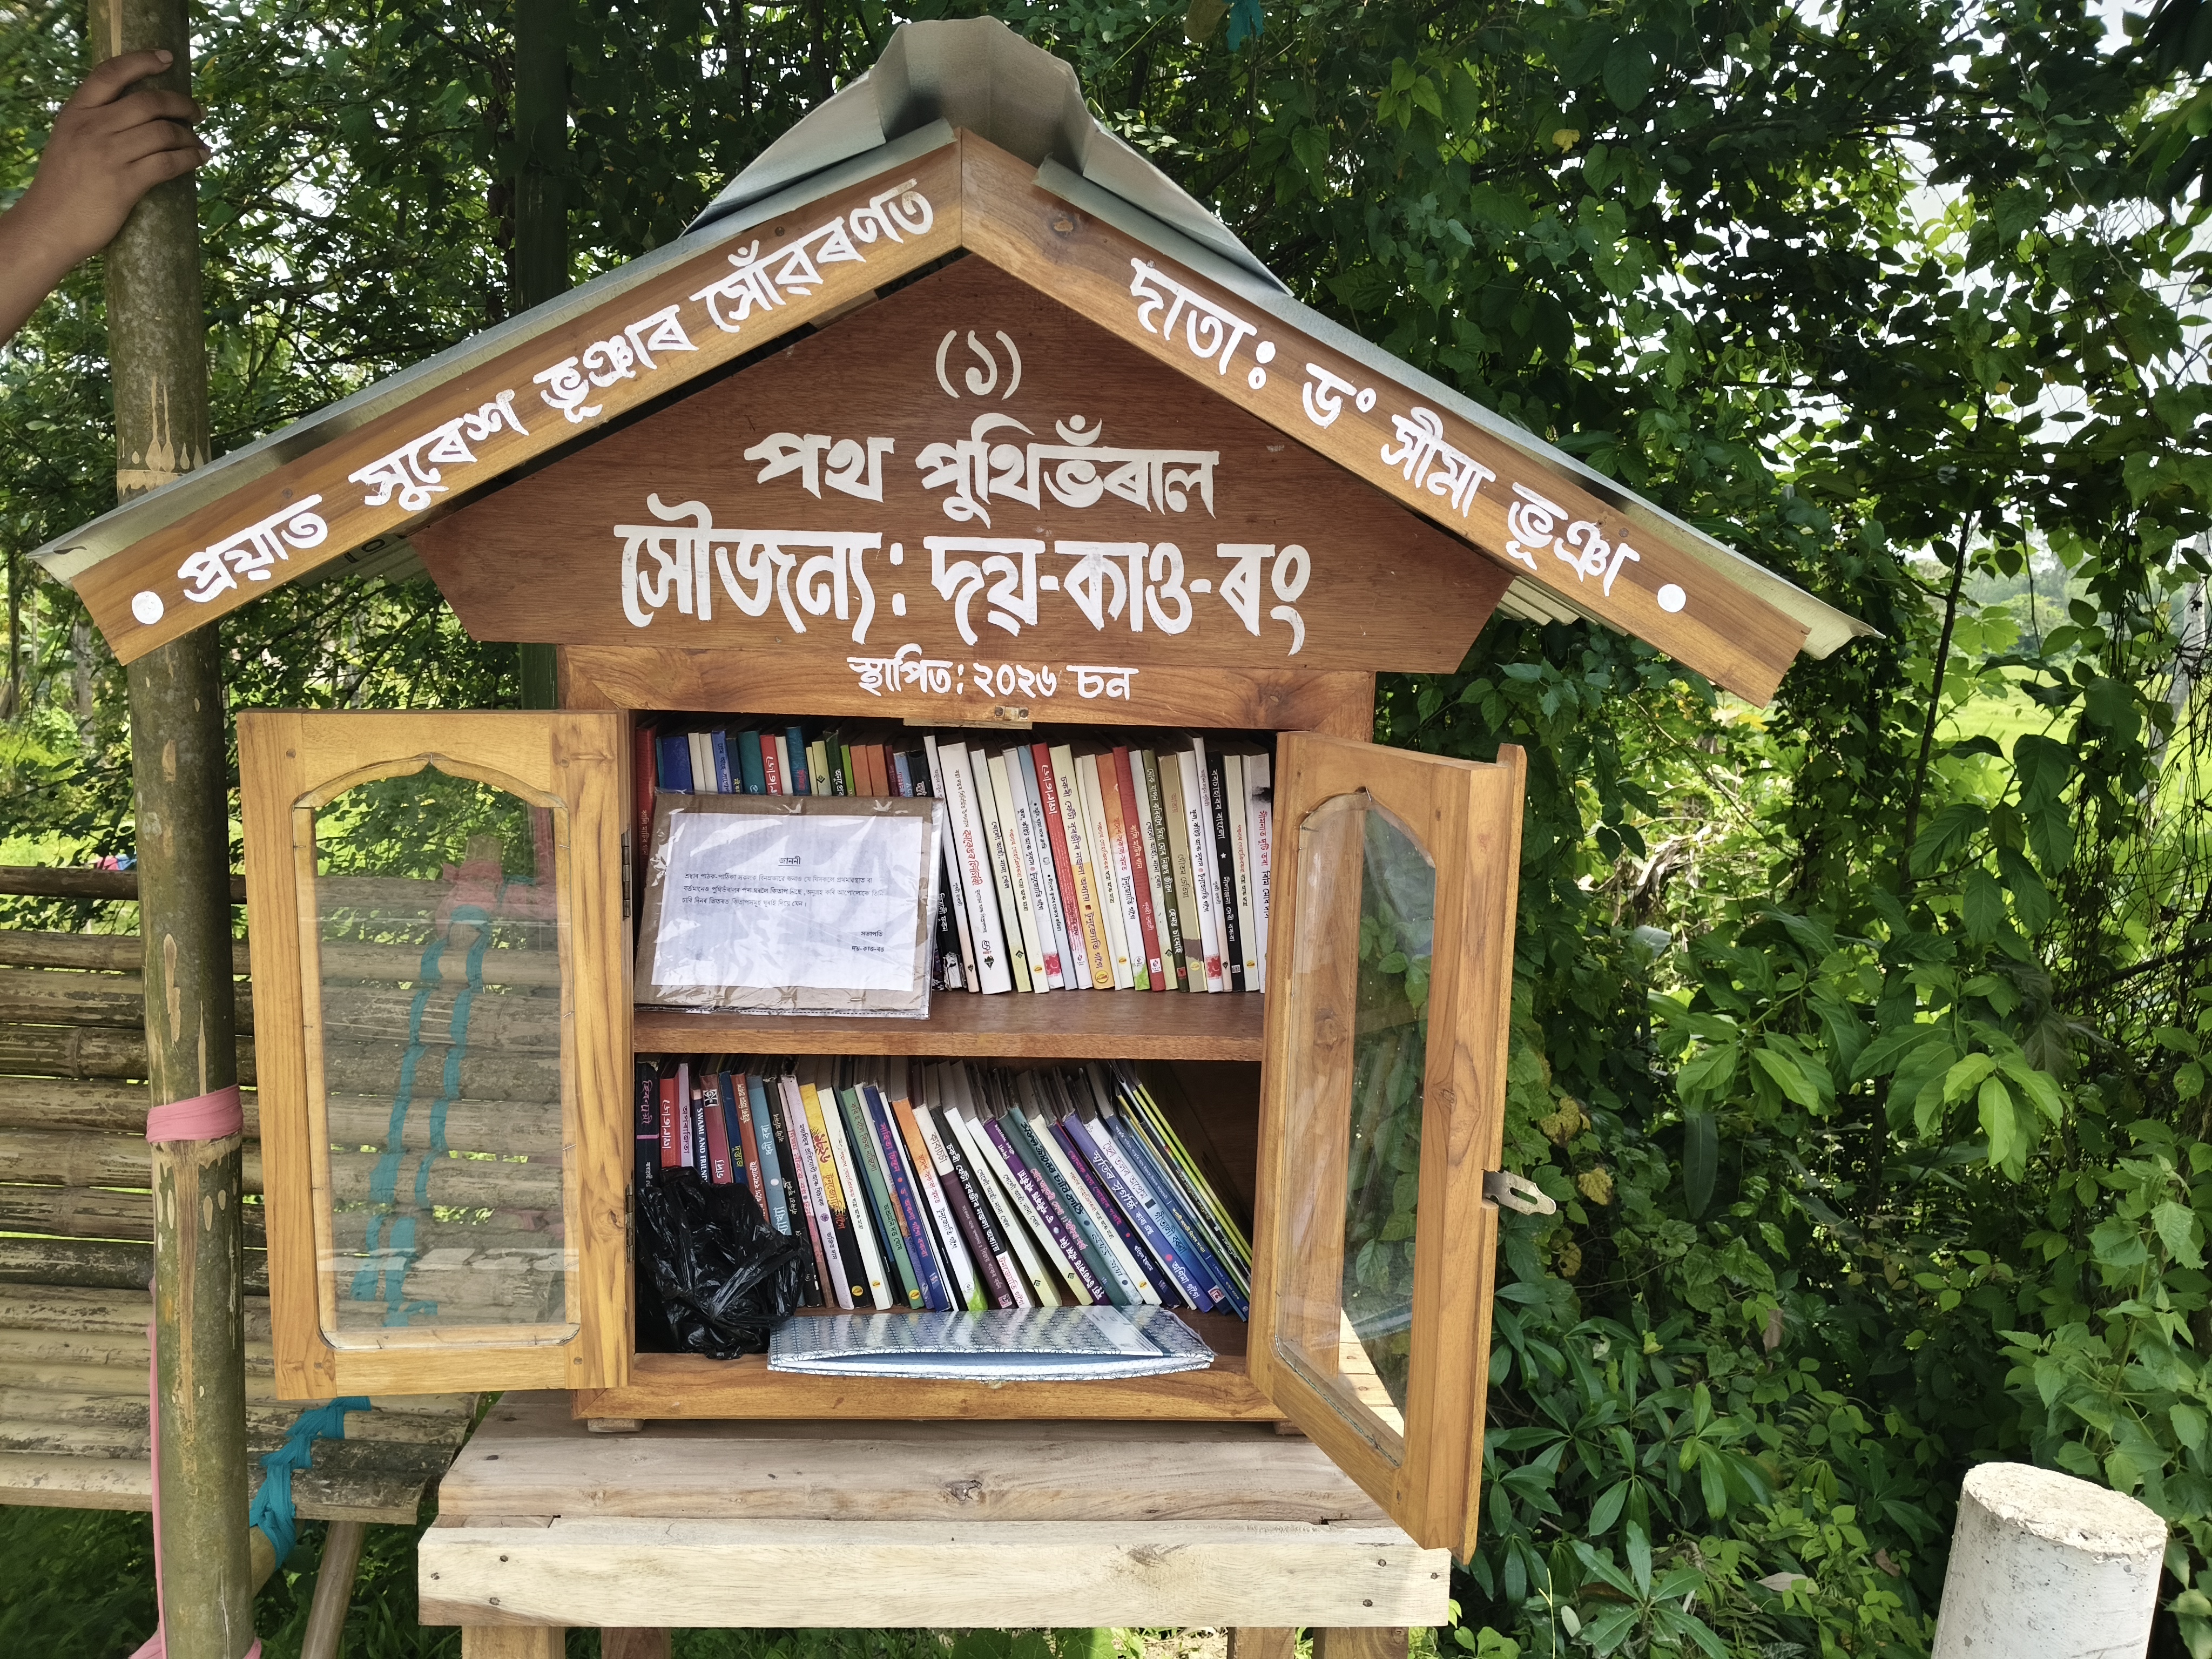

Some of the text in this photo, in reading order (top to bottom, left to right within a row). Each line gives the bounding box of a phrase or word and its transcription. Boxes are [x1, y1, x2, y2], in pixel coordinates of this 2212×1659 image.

[178, 494, 328, 602] প্ৰয়াত
[346, 386, 529, 511] সুৰেশ
[533, 305, 699, 423] ভূঞাৰ
[744, 413, 1219, 529] পথ পুথিভঁৰাল
[1381, 402, 1499, 518] সীমা
[1506, 478, 1643, 597] ভূঞা
[973, 663, 1057, 698] ২০২৬
[1066, 665, 1139, 700] চন
[1060, 775, 1072, 797] চকৰী
[1215, 812, 1225, 839] বাংলো
[1129, 824, 1139, 839] ঝালি
[1134, 858, 1143, 868] গান
[1177, 854, 1187, 874] গৌতম
[1079, 876, 1090, 901] অধ্যায়
[1180, 876, 1191, 898] চেতিয়া
[1127, 906, 1136, 920] গগৈ
[1084, 912, 1101, 950] টুনুজ্যোতি
[1094, 952, 1103, 968] গগৈ
[682, 1105, 690, 1153] অপৰাজিতা
[878, 1122, 894, 1149] সাহিত্য
[911, 1220, 921, 1236] গগৈ
[994, 1202, 1003, 1213] নানা
[1153, 1210, 1176, 1236] গীতালী
[893, 1237, 902, 1250] ঘোষ
[1185, 1283, 1201, 1299] গগৈ
